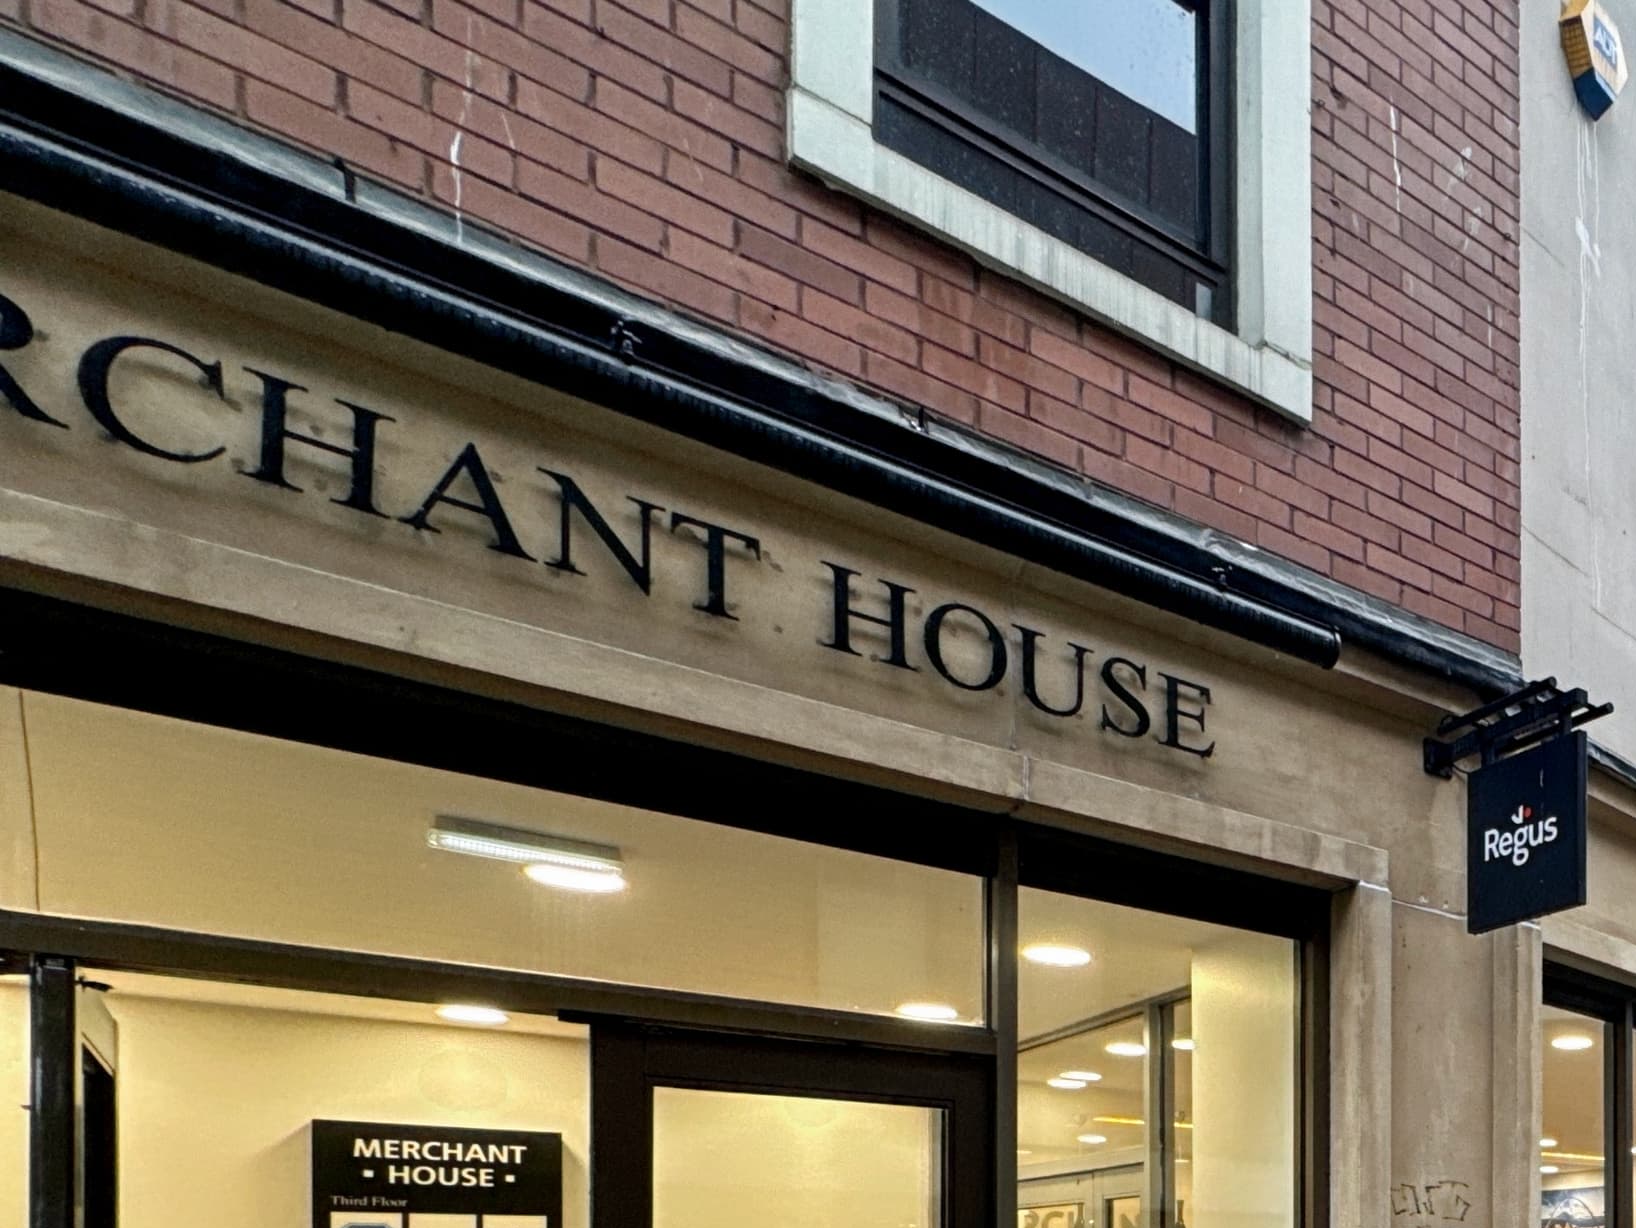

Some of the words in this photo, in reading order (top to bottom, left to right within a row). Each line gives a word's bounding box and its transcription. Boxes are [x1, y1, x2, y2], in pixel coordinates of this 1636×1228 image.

[818, 559, 1216, 761] HOUSE
[1484, 816, 1558, 867] Regus
[353, 1138, 527, 1164] MERCHANT
[388, 1165, 495, 1187] HOUSE
[331, 1195, 368, 1206] Third
[372, 1196, 408, 1207] Floor
